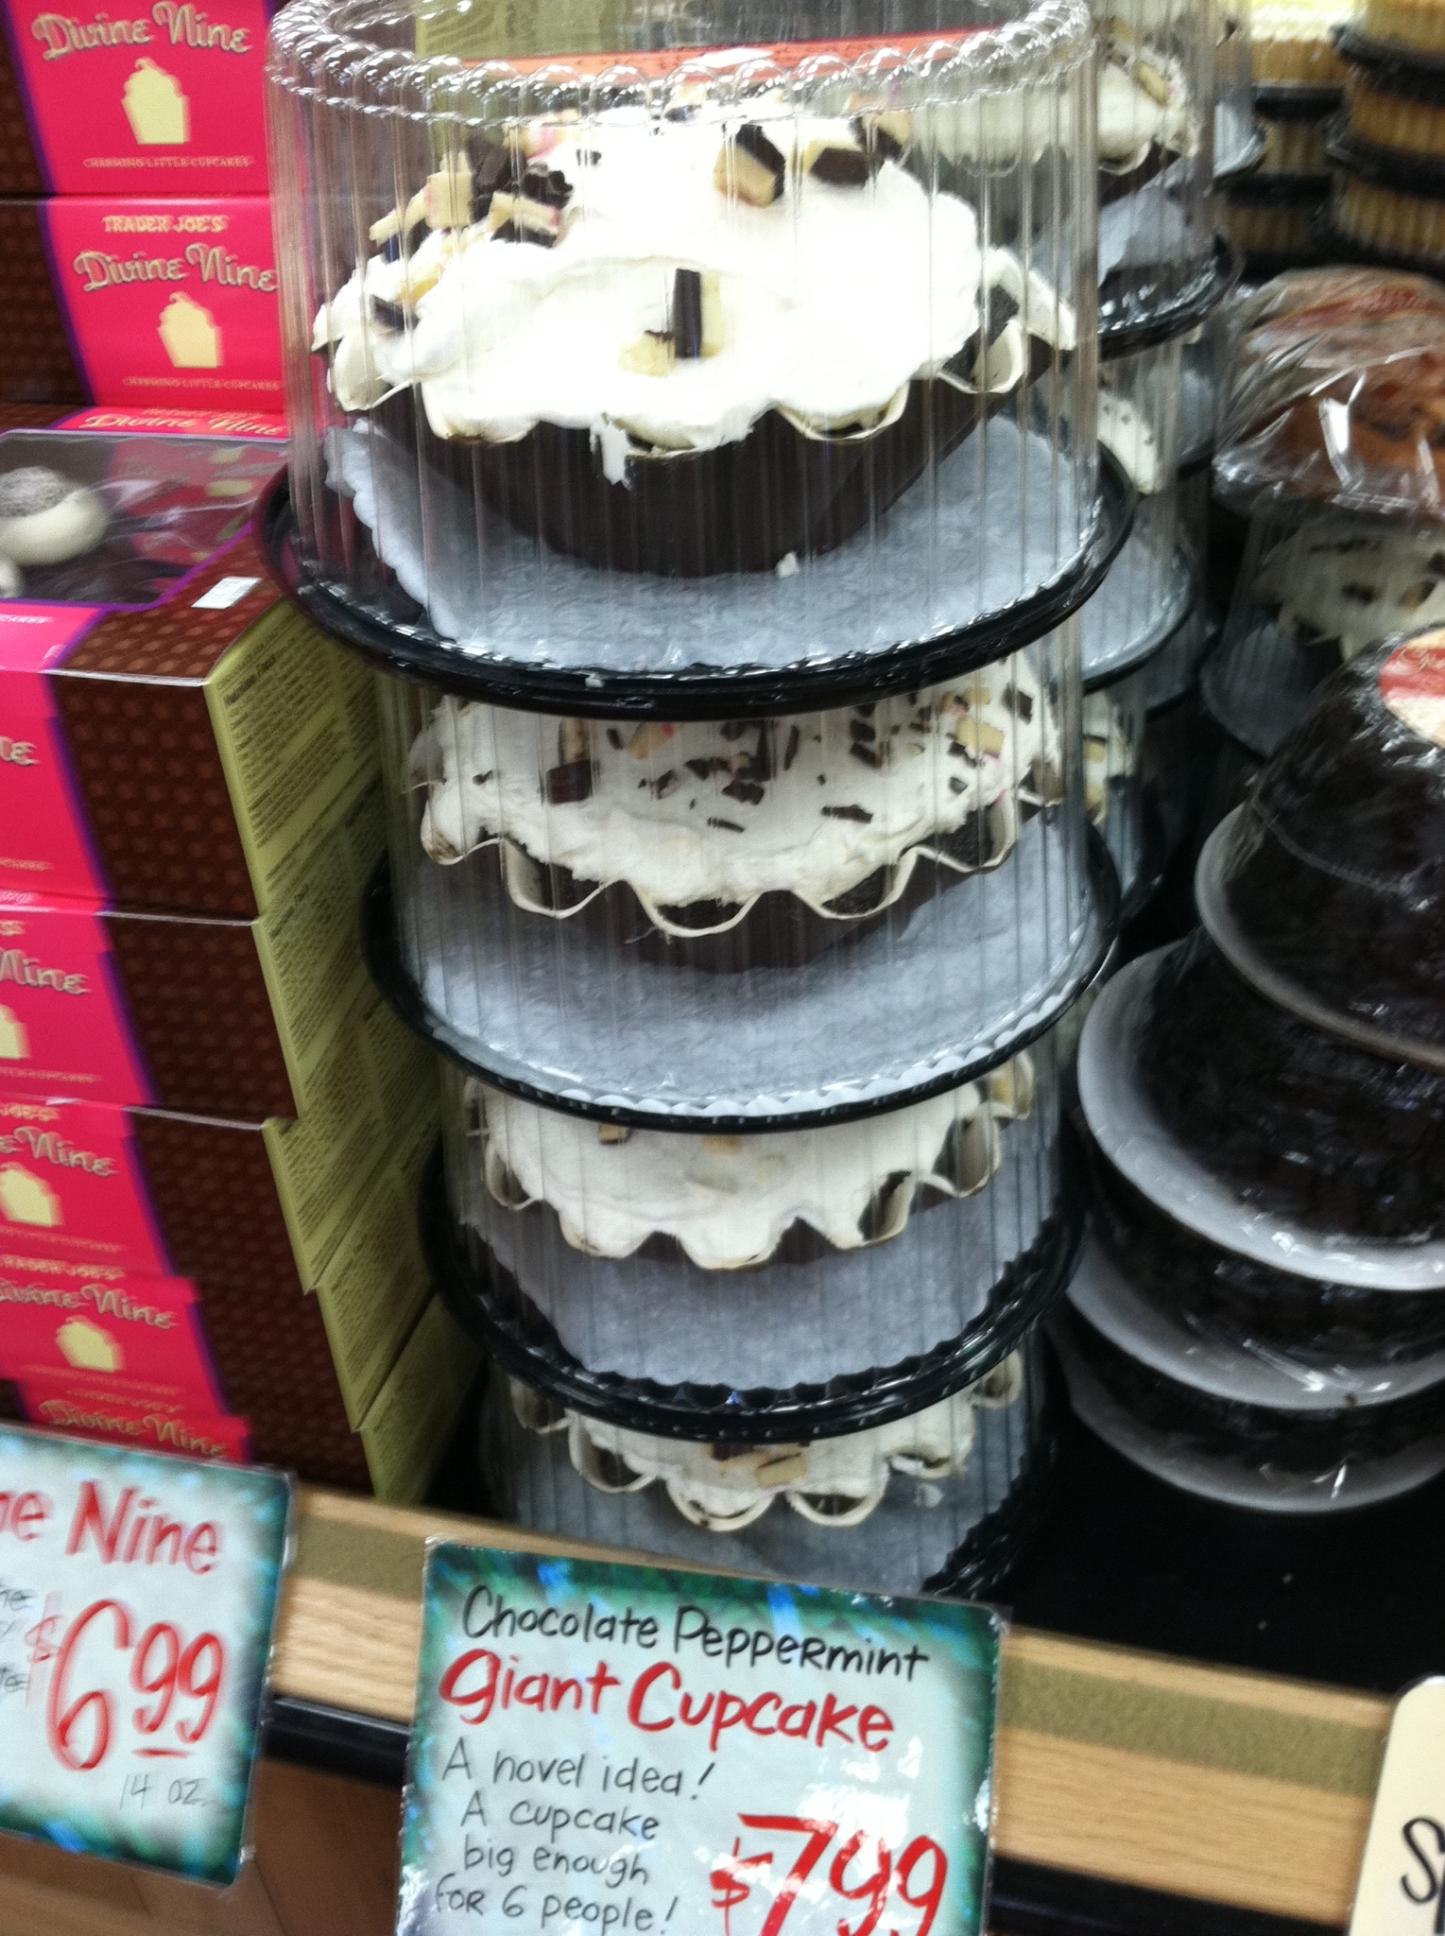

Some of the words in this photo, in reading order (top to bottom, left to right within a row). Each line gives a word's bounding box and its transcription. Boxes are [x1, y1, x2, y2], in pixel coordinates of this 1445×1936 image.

[31, 12, 153, 60] Divine
[152, 1, 252, 53] Nine
[102, 215, 170, 233] TRADER
[173, 215, 230, 233] JOE'S
[73, 250, 188, 292] Divine
[185, 242, 279, 292] Nine
[65, 1480, 222, 1574] Nine
[462, 1585, 658, 1647] Chocolate
[627, 1661, 895, 1752] Cupcake
[119, 1773, 152, 1809] 14
[441, 1737, 473, 1781] A
[492, 1750, 586, 1788] novel
[602, 1756, 716, 1801] idea!
[460, 1790, 488, 1827] A
[508, 1800, 660, 1843] cupcake
[463, 1834, 515, 1877] big
[532, 1846, 649, 1889] enough
[502, 1885, 528, 1919] 6
[540, 1896, 679, 1936] people!
